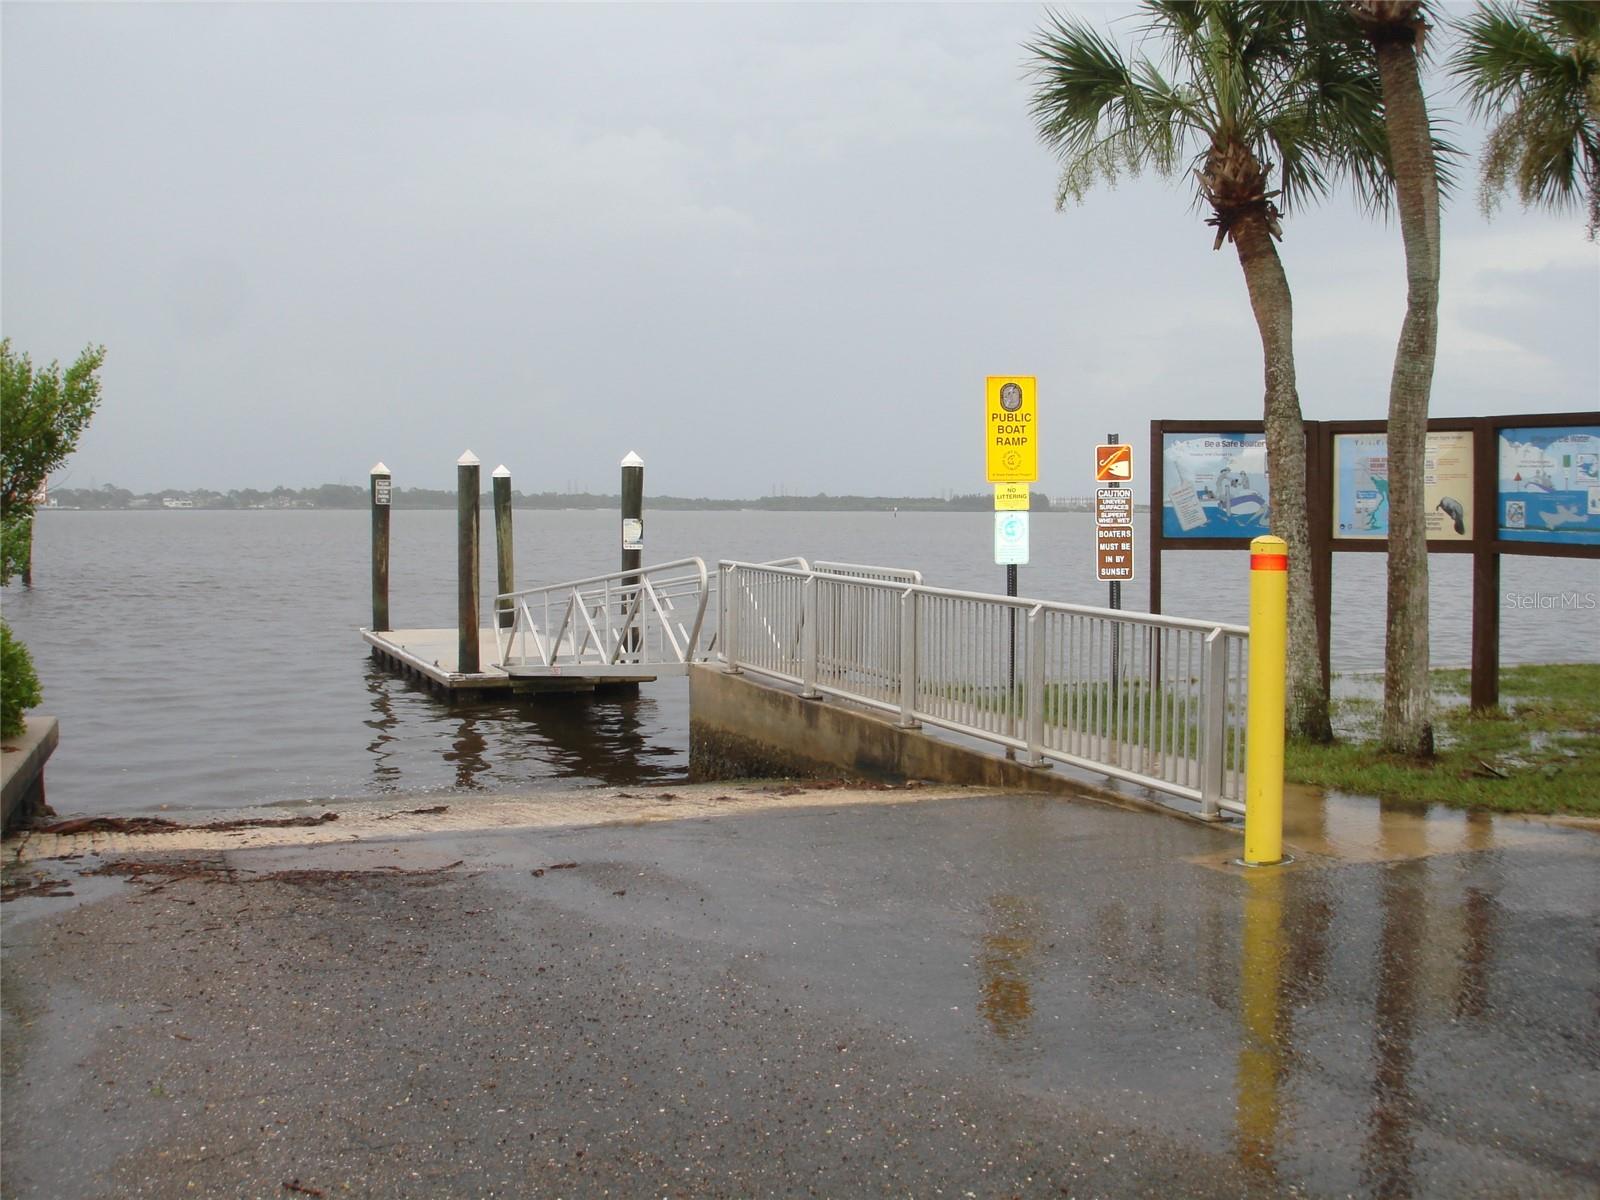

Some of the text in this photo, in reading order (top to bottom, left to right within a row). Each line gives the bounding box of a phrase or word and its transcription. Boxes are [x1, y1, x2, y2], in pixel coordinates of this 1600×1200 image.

[992, 413, 1032, 422] PUBLIC
[997, 425, 1026, 434] BOAT
[996, 437, 1028, 446] RAMP
[1204, 440, 1214, 448] Be
[1222, 440, 1239, 448] Safe
[1240, 440, 1265, 448] Boater
[1098, 530, 1131, 538] BOATERS
[1099, 543, 1131, 551] MUST BE
[1105, 555, 1125, 563] IN BY
[1101, 567, 1130, 576] SUNSET
